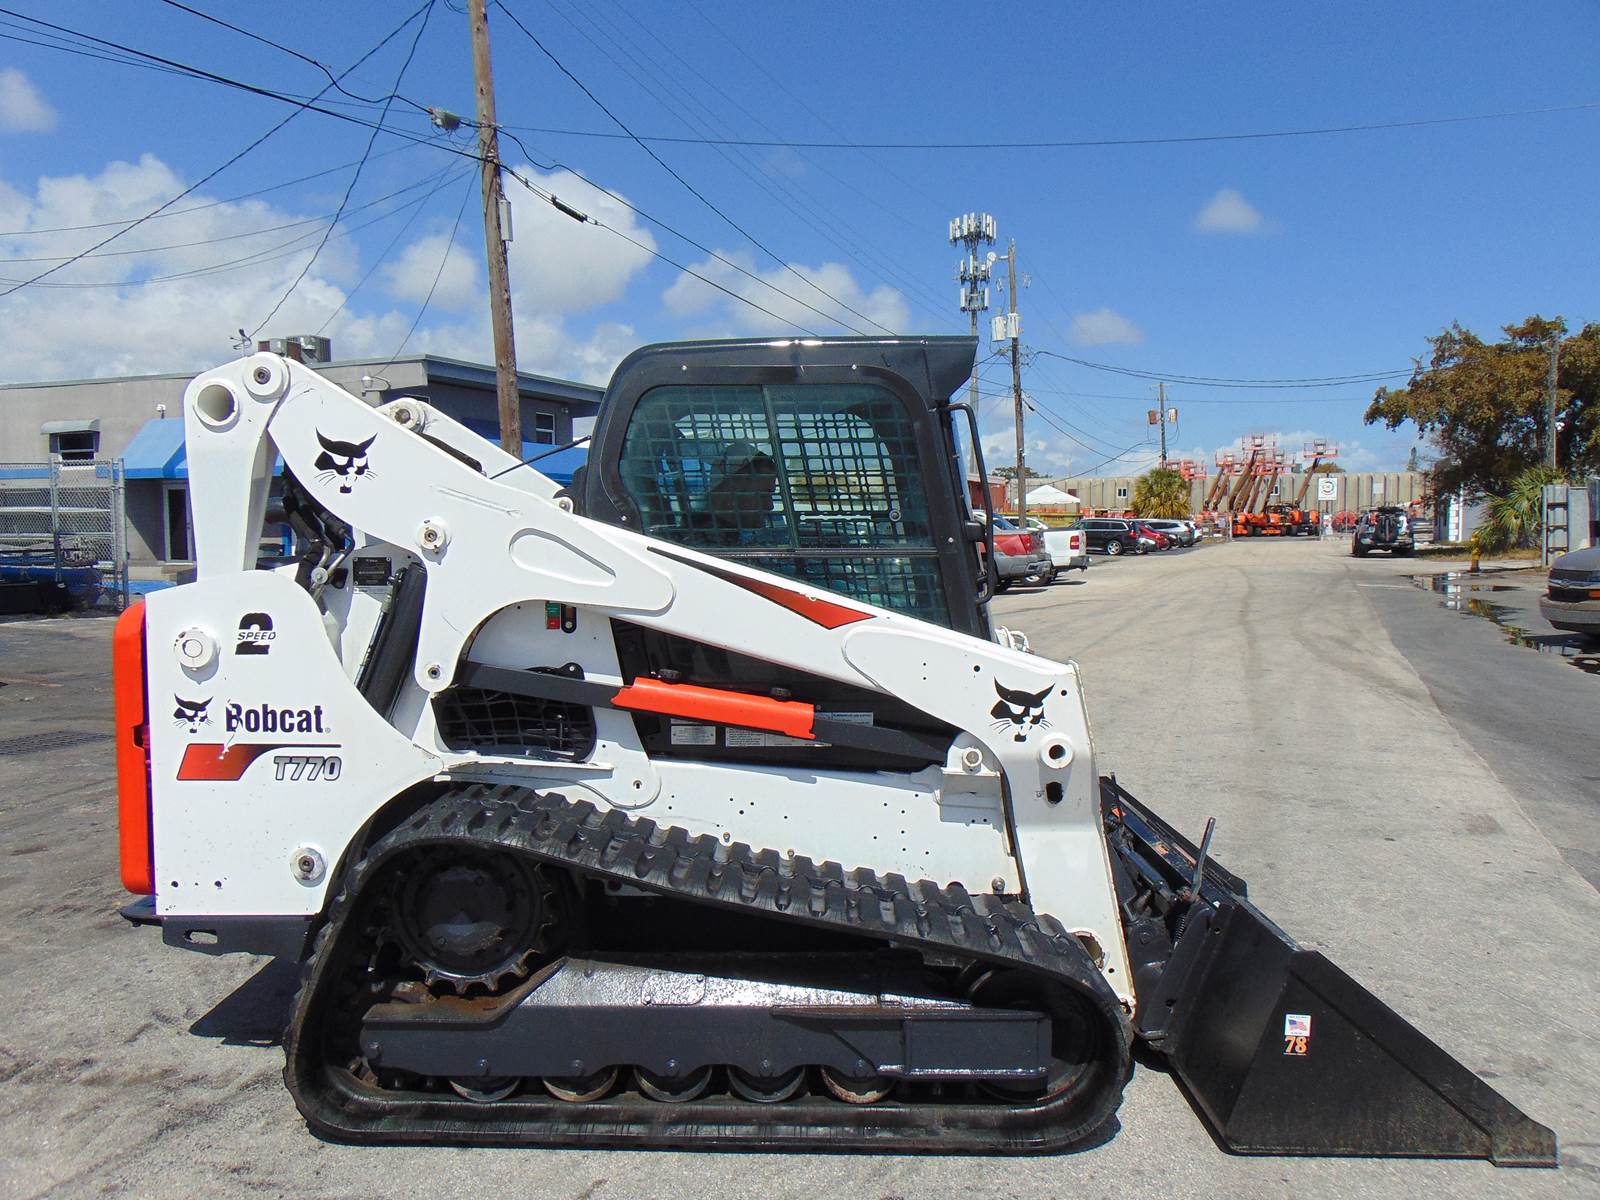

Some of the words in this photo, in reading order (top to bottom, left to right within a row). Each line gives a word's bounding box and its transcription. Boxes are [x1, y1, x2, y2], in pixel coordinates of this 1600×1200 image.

[235, 612, 274, 655] 2
[237, 631, 277, 641] SPEED
[225, 703, 324, 733] Bobcat
[273, 755, 343, 782] T770
[1285, 1035, 1307, 1053] 78
